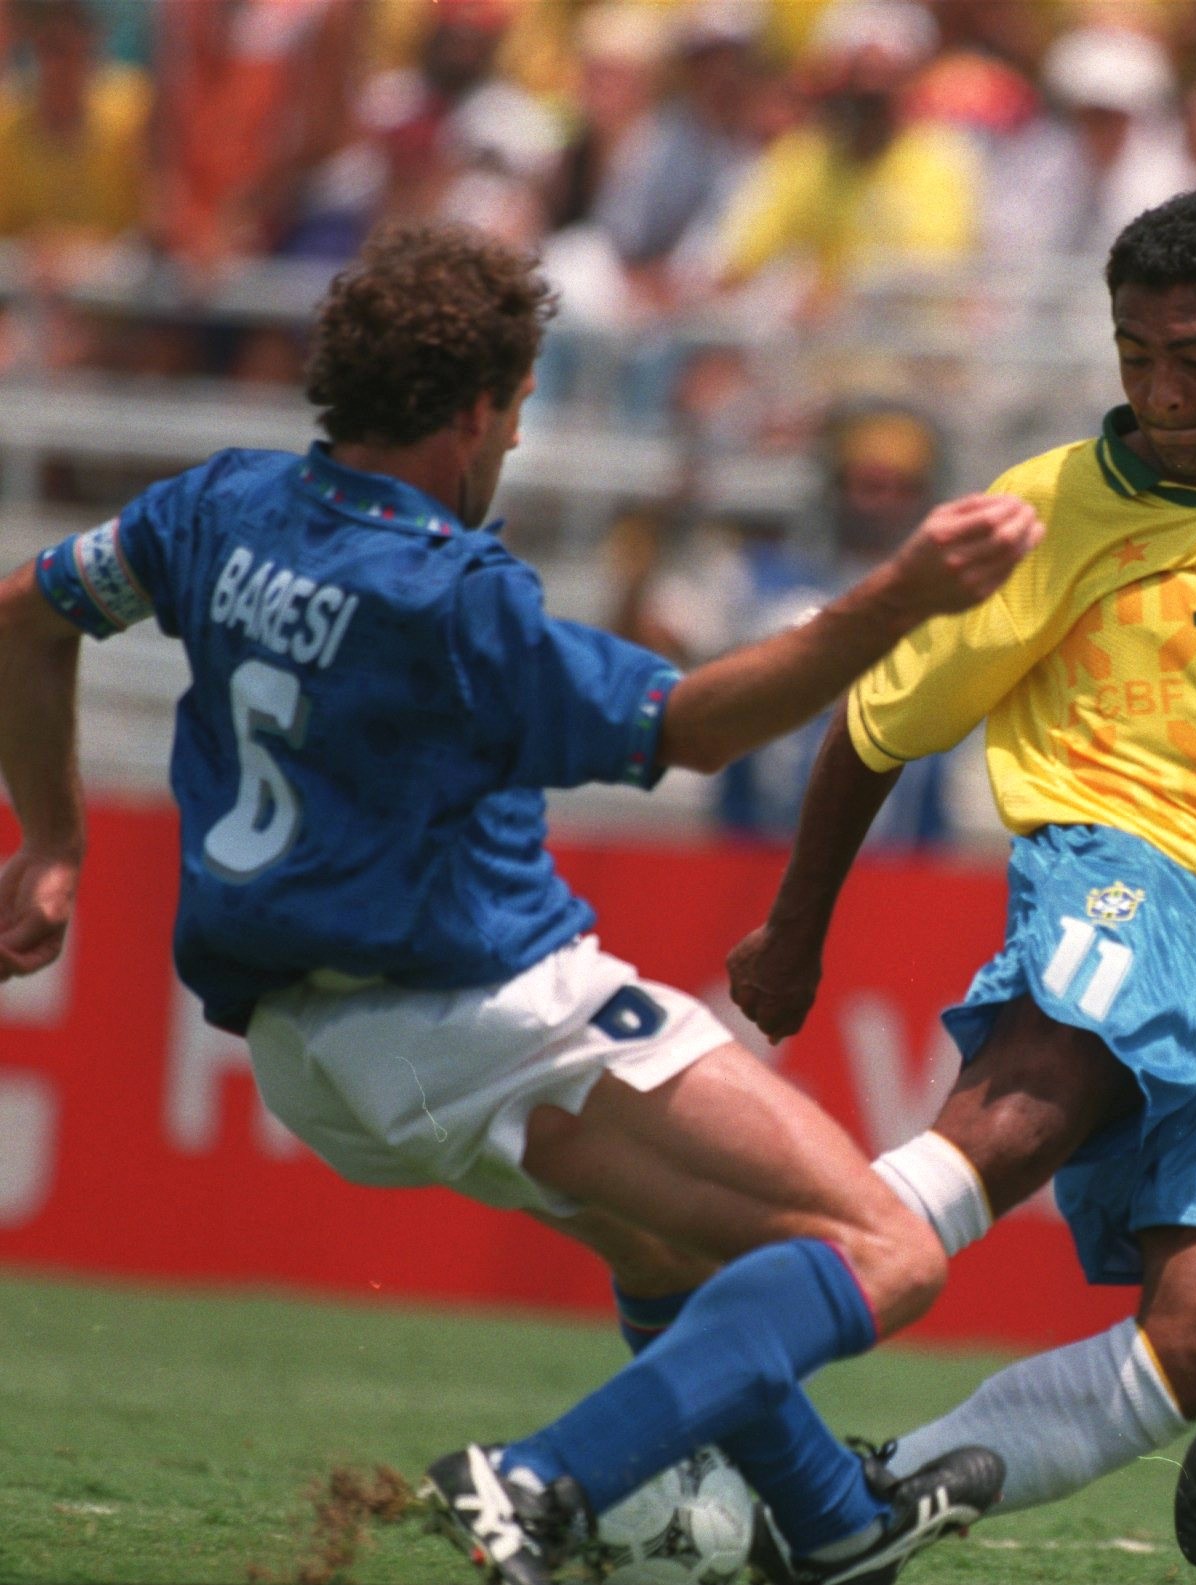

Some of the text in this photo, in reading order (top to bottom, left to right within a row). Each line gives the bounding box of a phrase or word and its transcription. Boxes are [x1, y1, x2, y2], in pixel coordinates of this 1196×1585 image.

[210, 546, 359, 669] BARESI
[1095, 678, 1184, 720] CBF
[203, 658, 309, 882] 6
[1041, 915, 1134, 1023] 11
